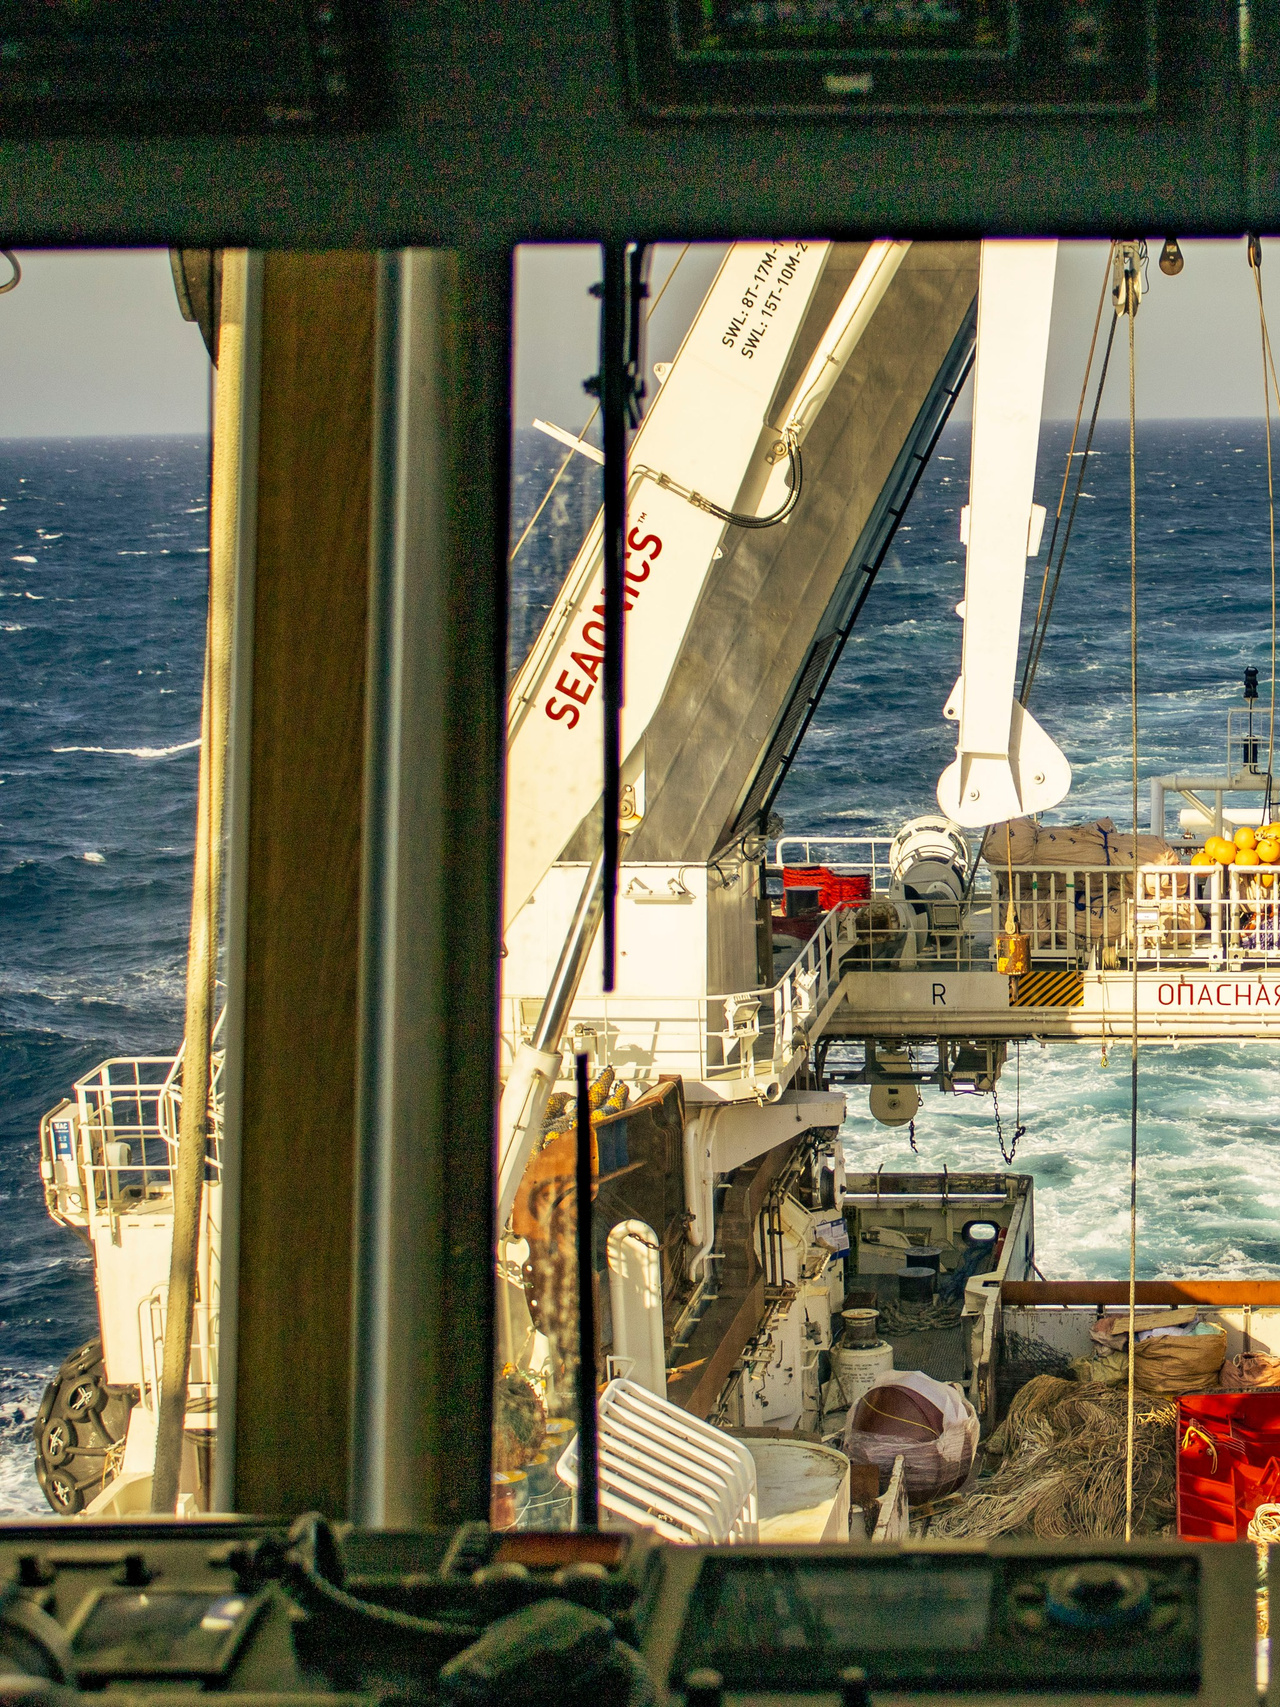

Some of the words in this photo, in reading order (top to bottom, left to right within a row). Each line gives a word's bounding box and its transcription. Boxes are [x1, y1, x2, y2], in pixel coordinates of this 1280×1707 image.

[721, 310, 749, 348] SWL:
[741, 321, 768, 359] SWL:
[932, 983, 946, 1005] R
